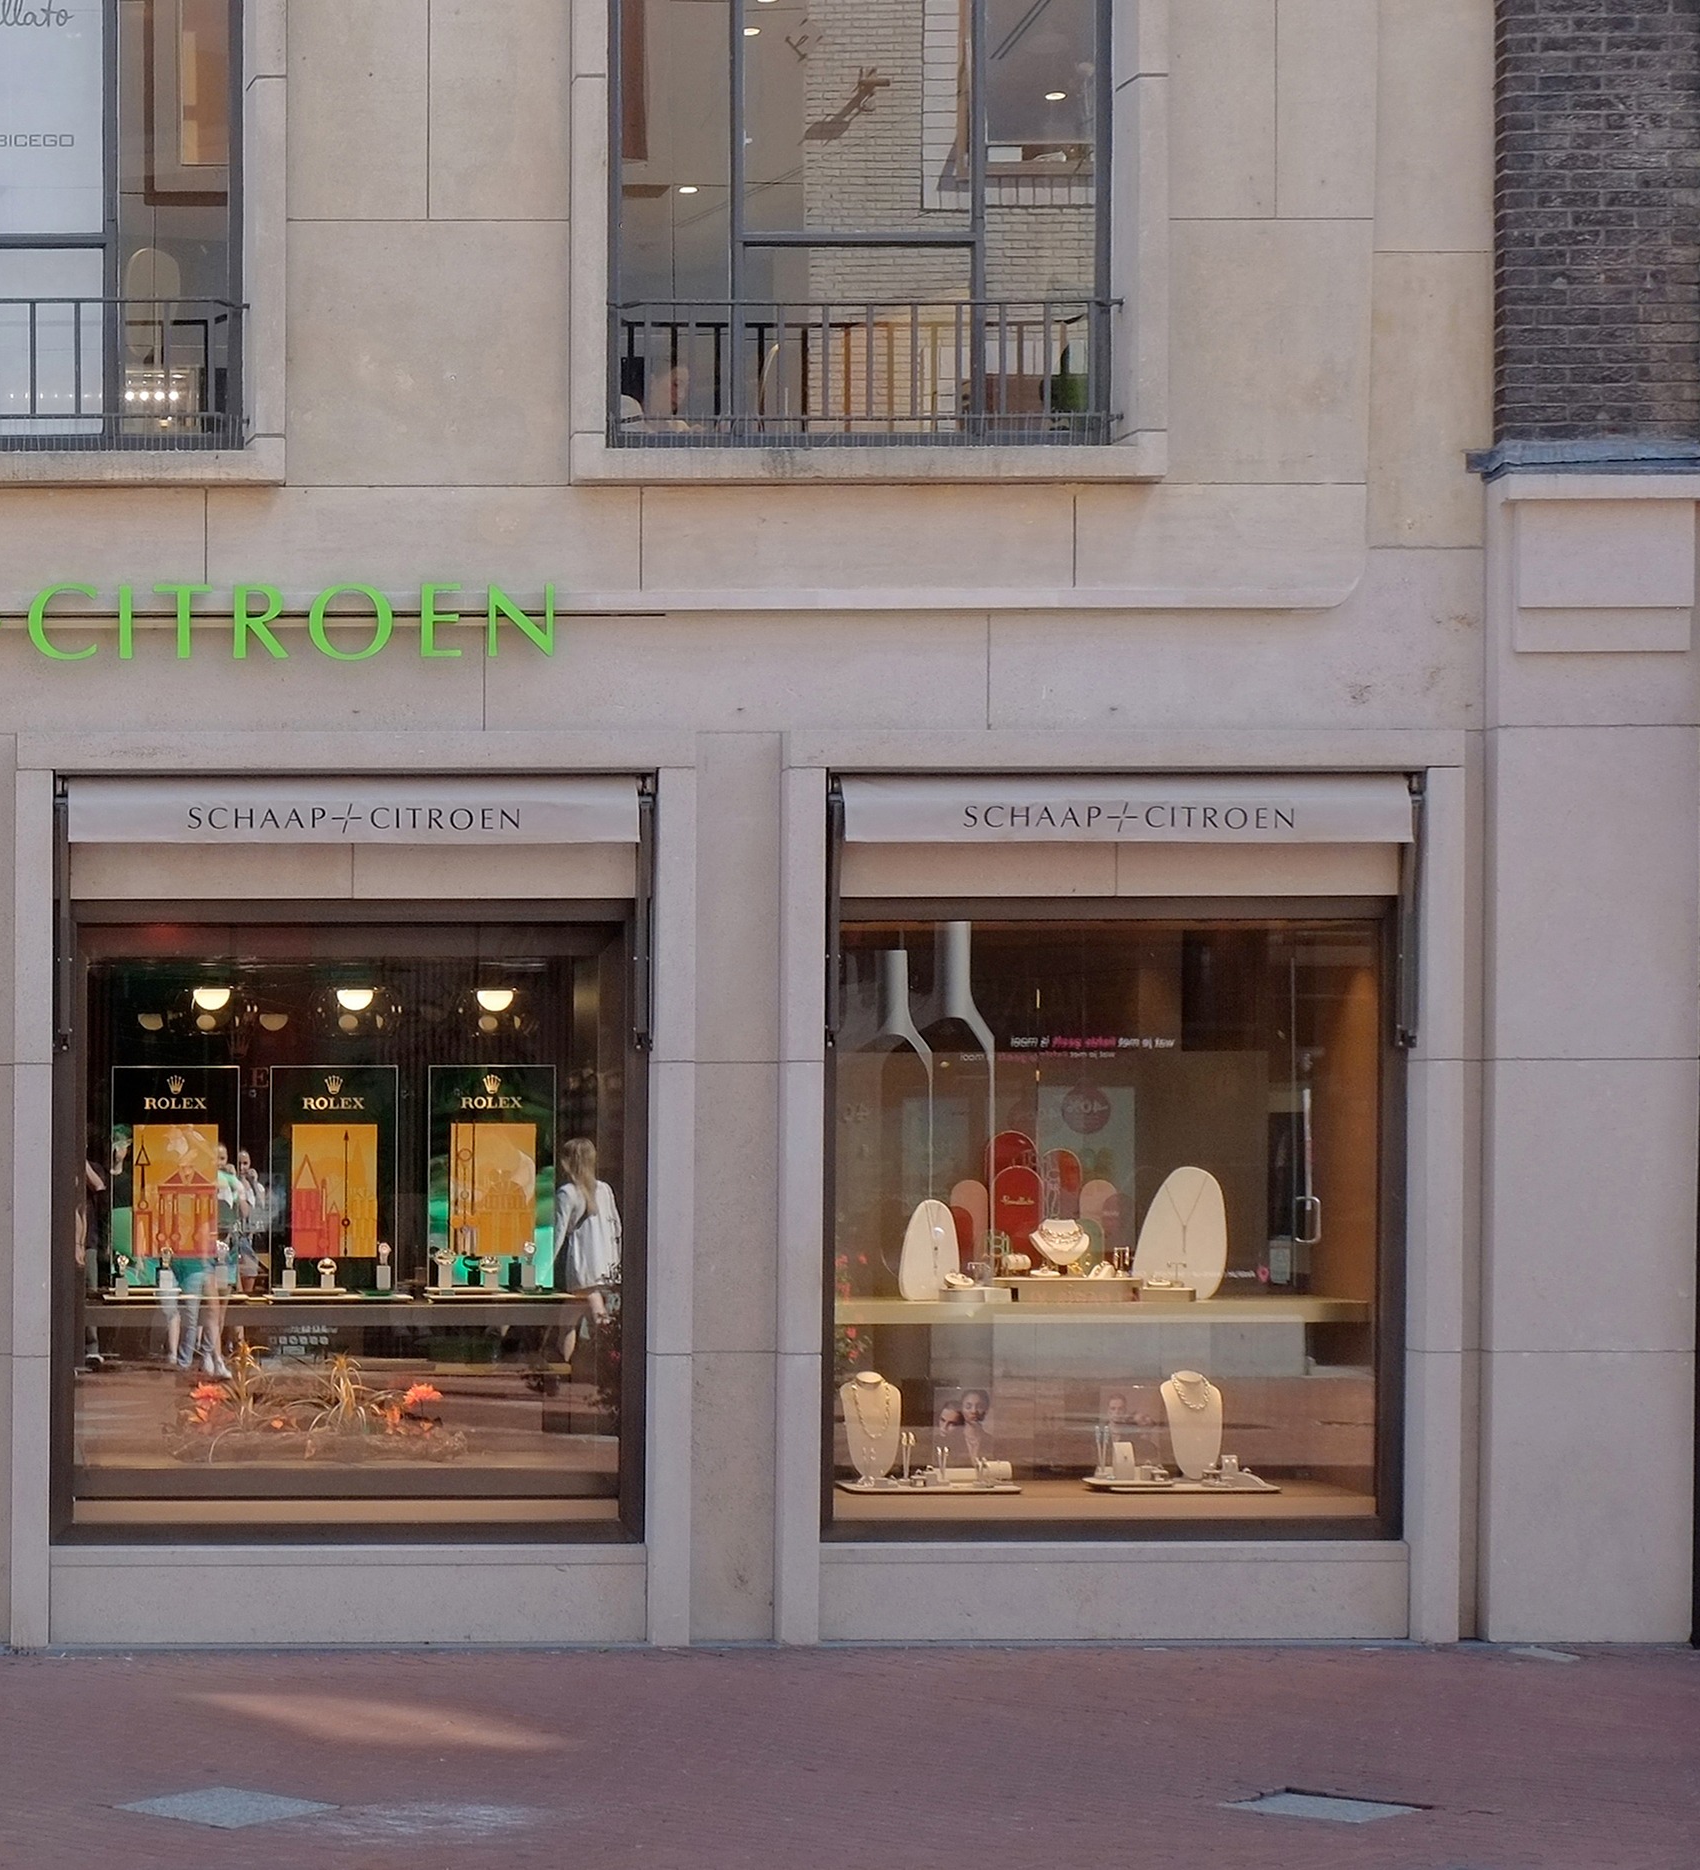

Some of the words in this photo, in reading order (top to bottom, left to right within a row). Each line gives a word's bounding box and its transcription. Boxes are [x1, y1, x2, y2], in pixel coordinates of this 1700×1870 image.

[27, 582, 554, 660] CITROEN
[187, 807, 326, 829] SCHAAP
[370, 807, 520, 830] CITROEN
[963, 805, 1102, 828] SCHAAP
[1145, 805, 1295, 829] CITROEN
[144, 1097, 207, 1110] ROLEX
[302, 1097, 365, 1110] ROLEX
[460, 1097, 523, 1109] ROLEX
